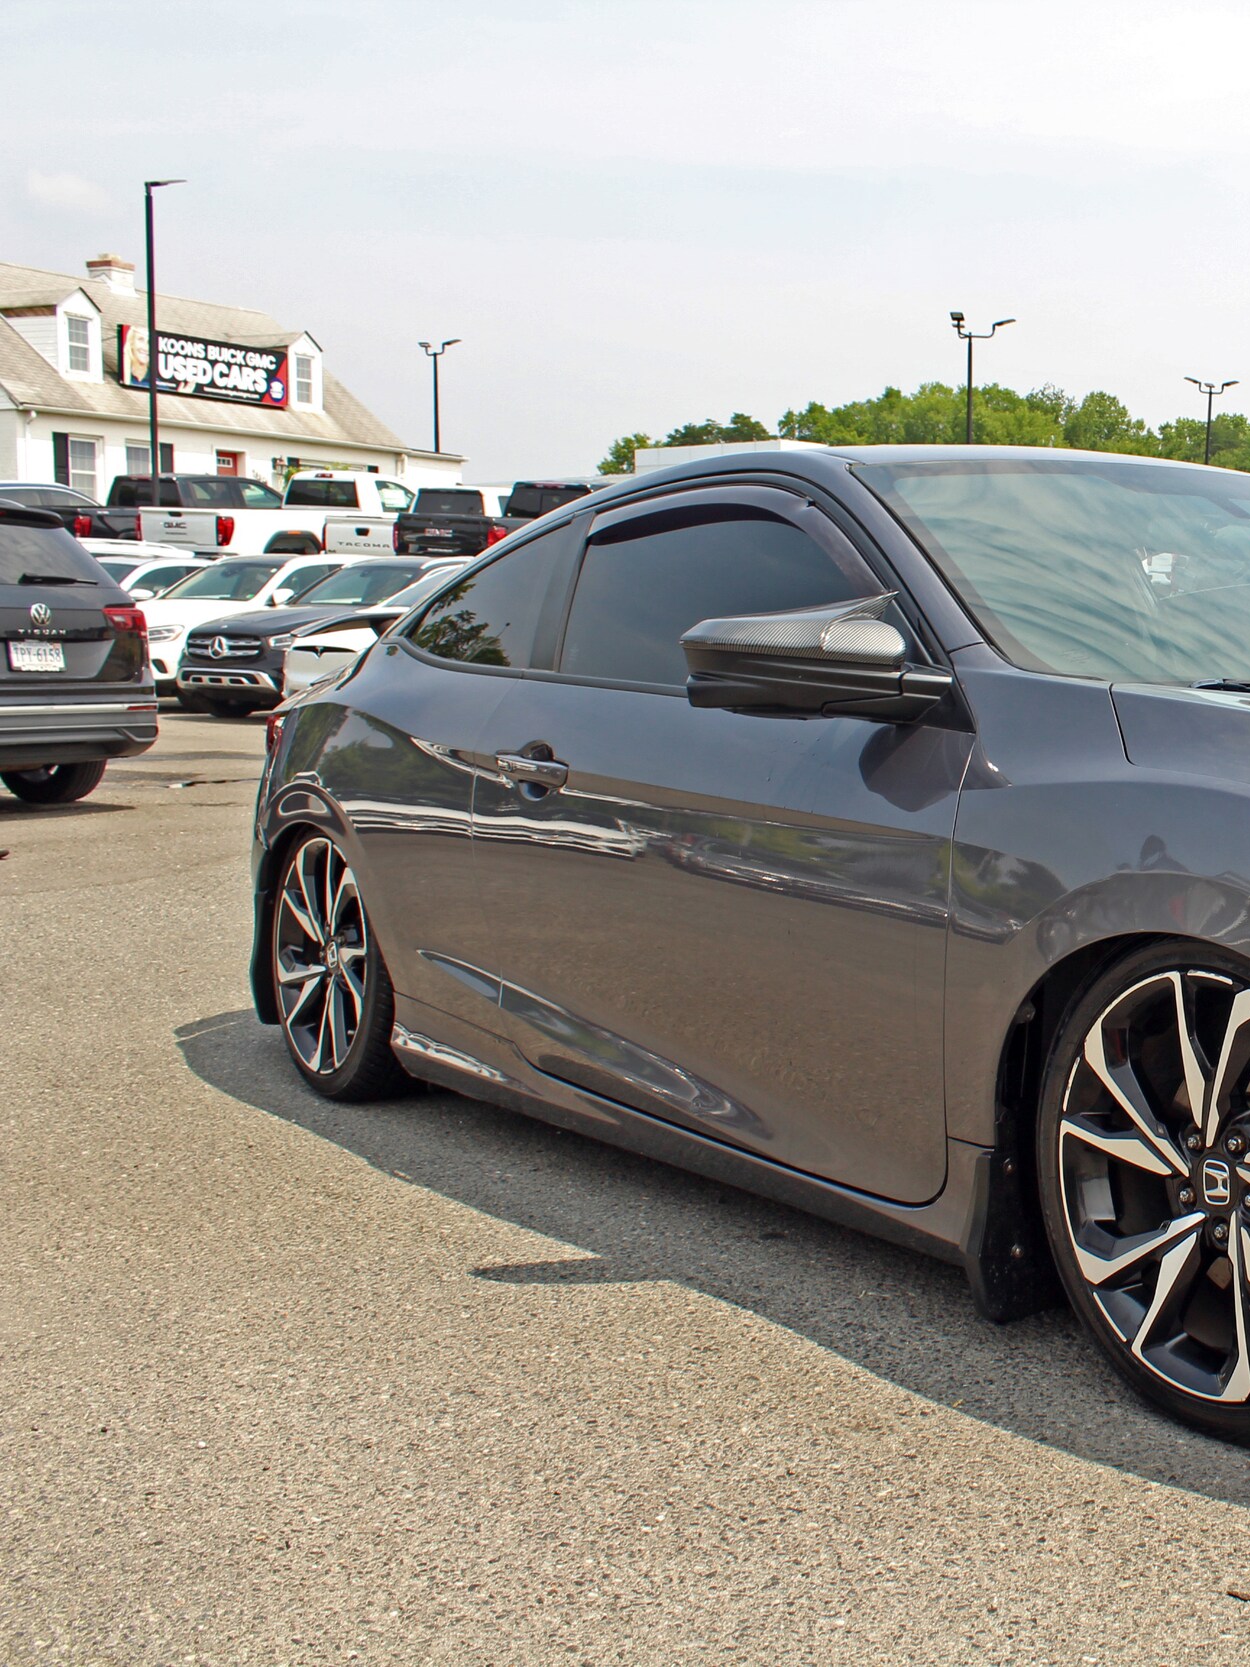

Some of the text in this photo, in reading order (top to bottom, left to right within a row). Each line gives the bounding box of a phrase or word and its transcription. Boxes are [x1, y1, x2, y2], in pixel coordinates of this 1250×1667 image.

[158, 336, 277, 370] KOONS BUICK GMC
[158, 353, 213, 385] USED
[213, 362, 268, 393] CARS
[337, 541, 391, 549] TACOMA
